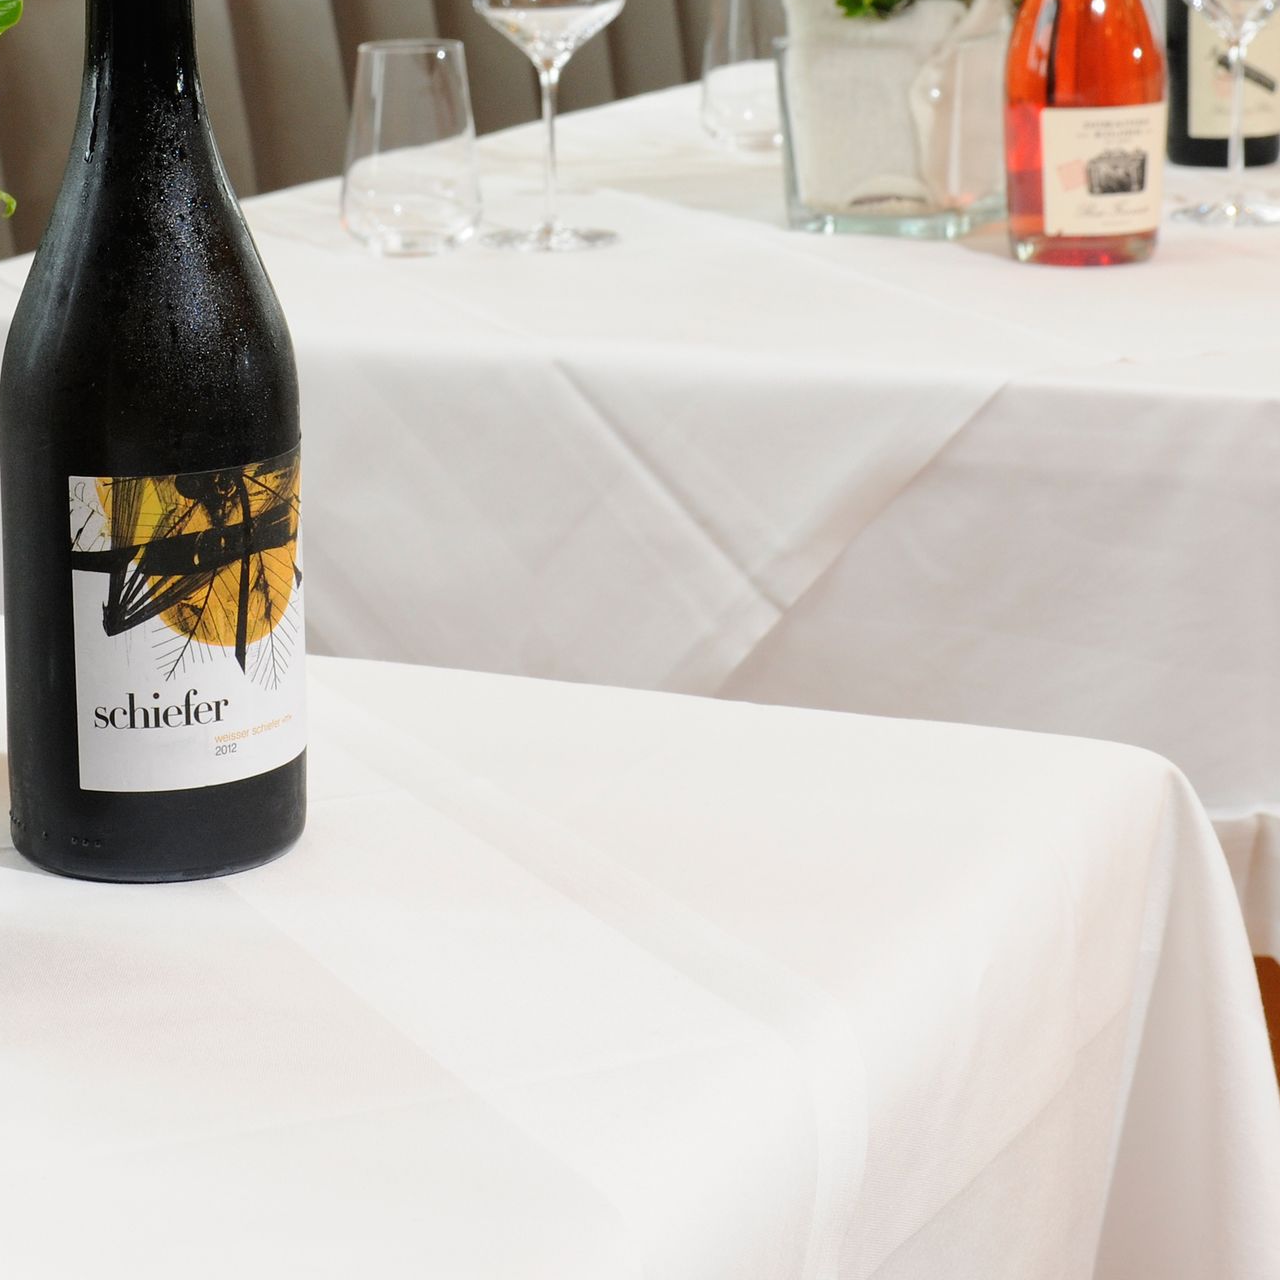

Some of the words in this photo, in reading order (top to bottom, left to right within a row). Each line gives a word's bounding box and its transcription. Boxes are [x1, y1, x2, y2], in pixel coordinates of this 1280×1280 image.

[94, 688, 229, 730] schiefer
[214, 729, 249, 743] weisser
[215, 742, 238, 756] 2012
